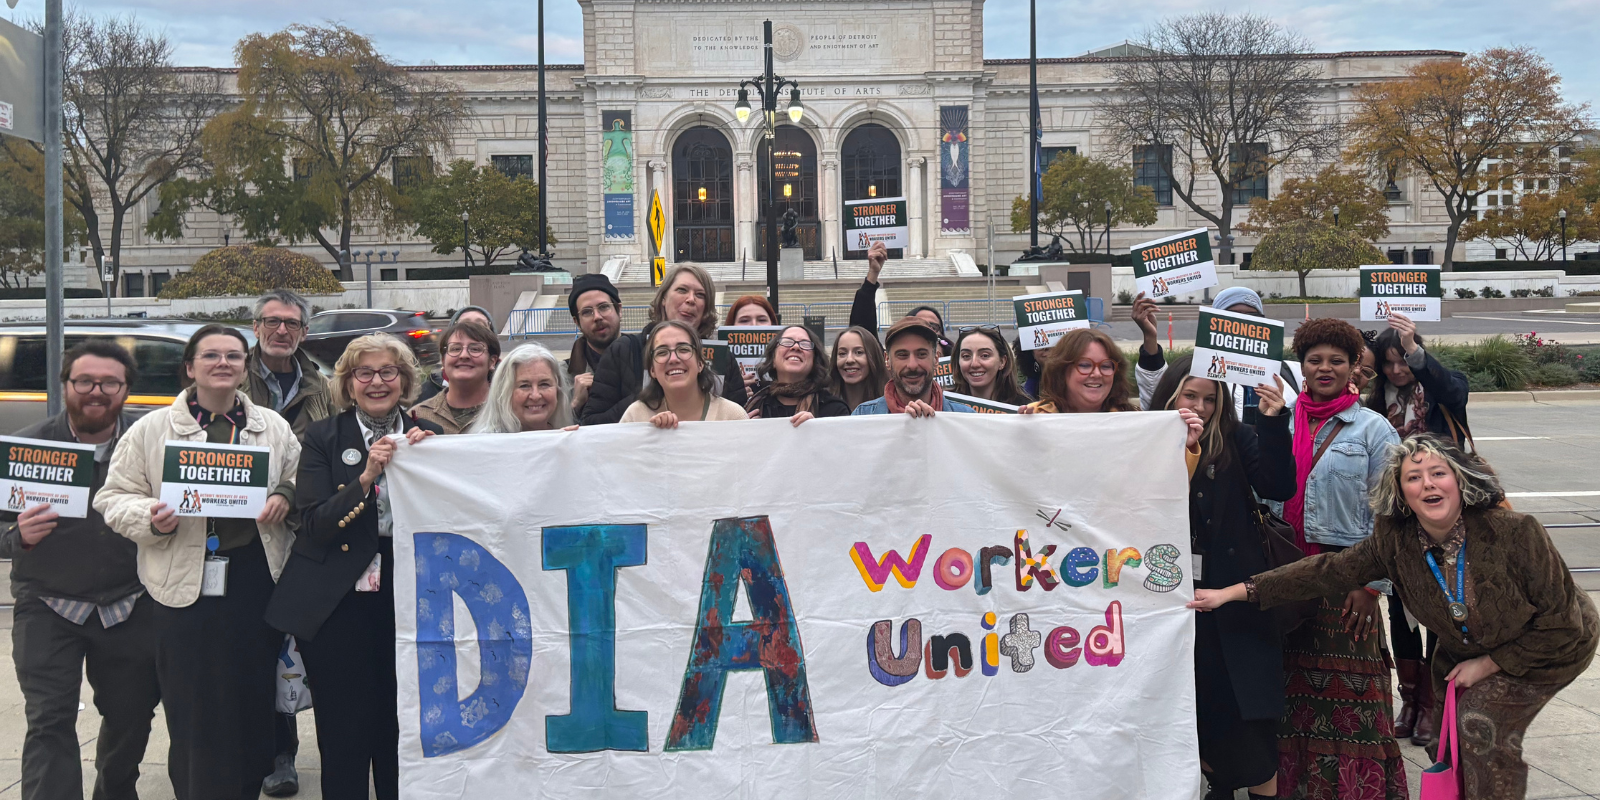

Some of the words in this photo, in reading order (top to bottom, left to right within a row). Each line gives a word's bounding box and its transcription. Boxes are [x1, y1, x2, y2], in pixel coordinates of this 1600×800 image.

[853, 204, 897, 216] STRONGER
[854, 215, 896, 227] TOGETHER
[1141, 238, 1197, 261] STRONGER
[1144, 250, 1199, 273] TOGETHER
[1370, 272, 1428, 283] STRONGER
[1371, 283, 1427, 295] TOGETHER
[1024, 297, 1075, 313] STRONGER
[1026, 308, 1076, 324] TOGETHER
[1210, 317, 1271, 341] STRONGER
[1209, 331, 1269, 355] TOGETHER
[1226, 364, 1248, 373] WORKERS
[1249, 368, 1266, 376] UNITED
[8, 446, 78, 467] STRONGER
[179, 450, 253, 468] STRONGER
[8, 461, 74, 482] TOGETHER
[179, 465, 251, 483] TOGETHER
[26, 495, 49, 503] WORKERS
[50, 497, 69, 505] UNITED
[201, 497, 228, 505] WORKERS
[229, 498, 248, 506] UNITED
[849, 529, 1183, 596] Workers
[412, 514, 820, 758] DIA
[866, 600, 1126, 687] United
